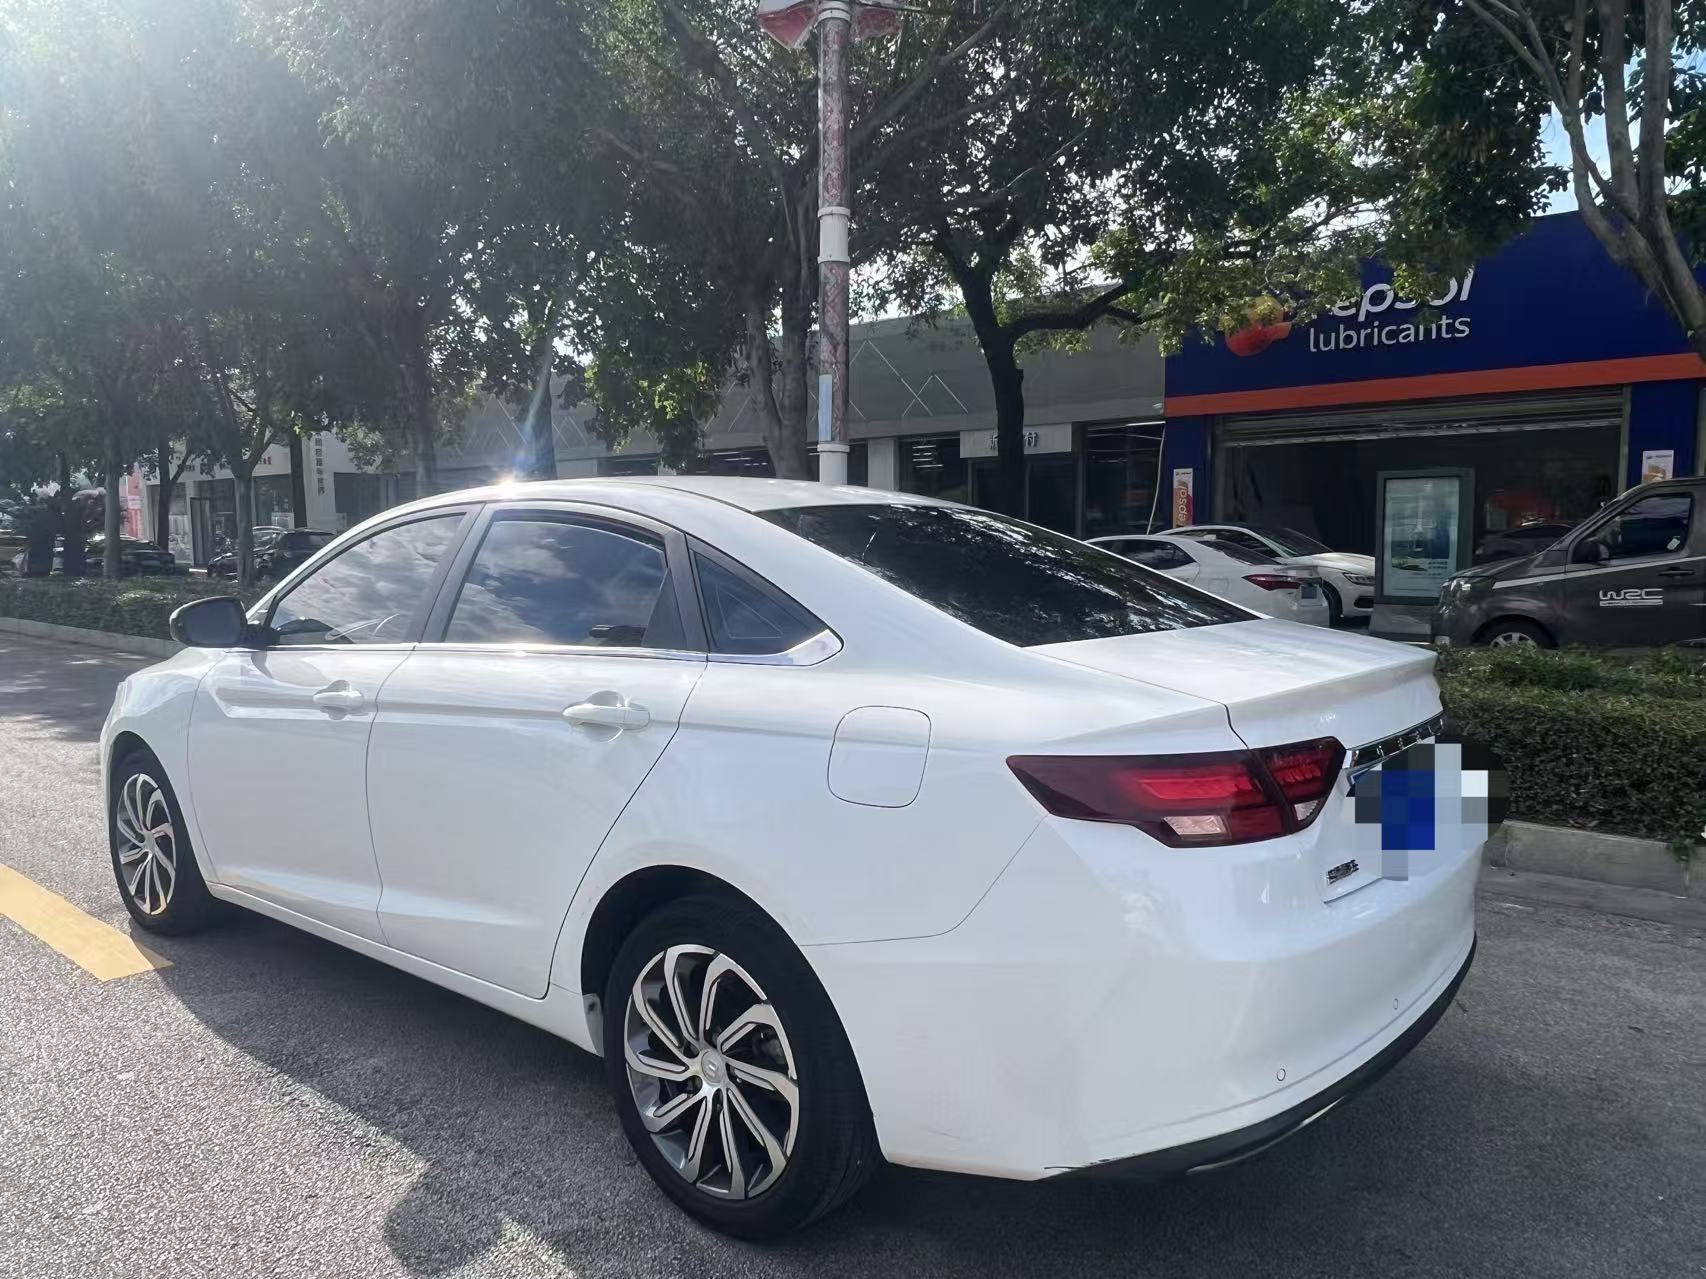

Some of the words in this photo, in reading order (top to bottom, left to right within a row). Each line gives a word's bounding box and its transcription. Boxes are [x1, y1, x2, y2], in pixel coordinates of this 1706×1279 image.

[1312, 266, 1474, 321] epol
[1310, 315, 1471, 352] lubricants
[1599, 588, 1664, 600] WRC
